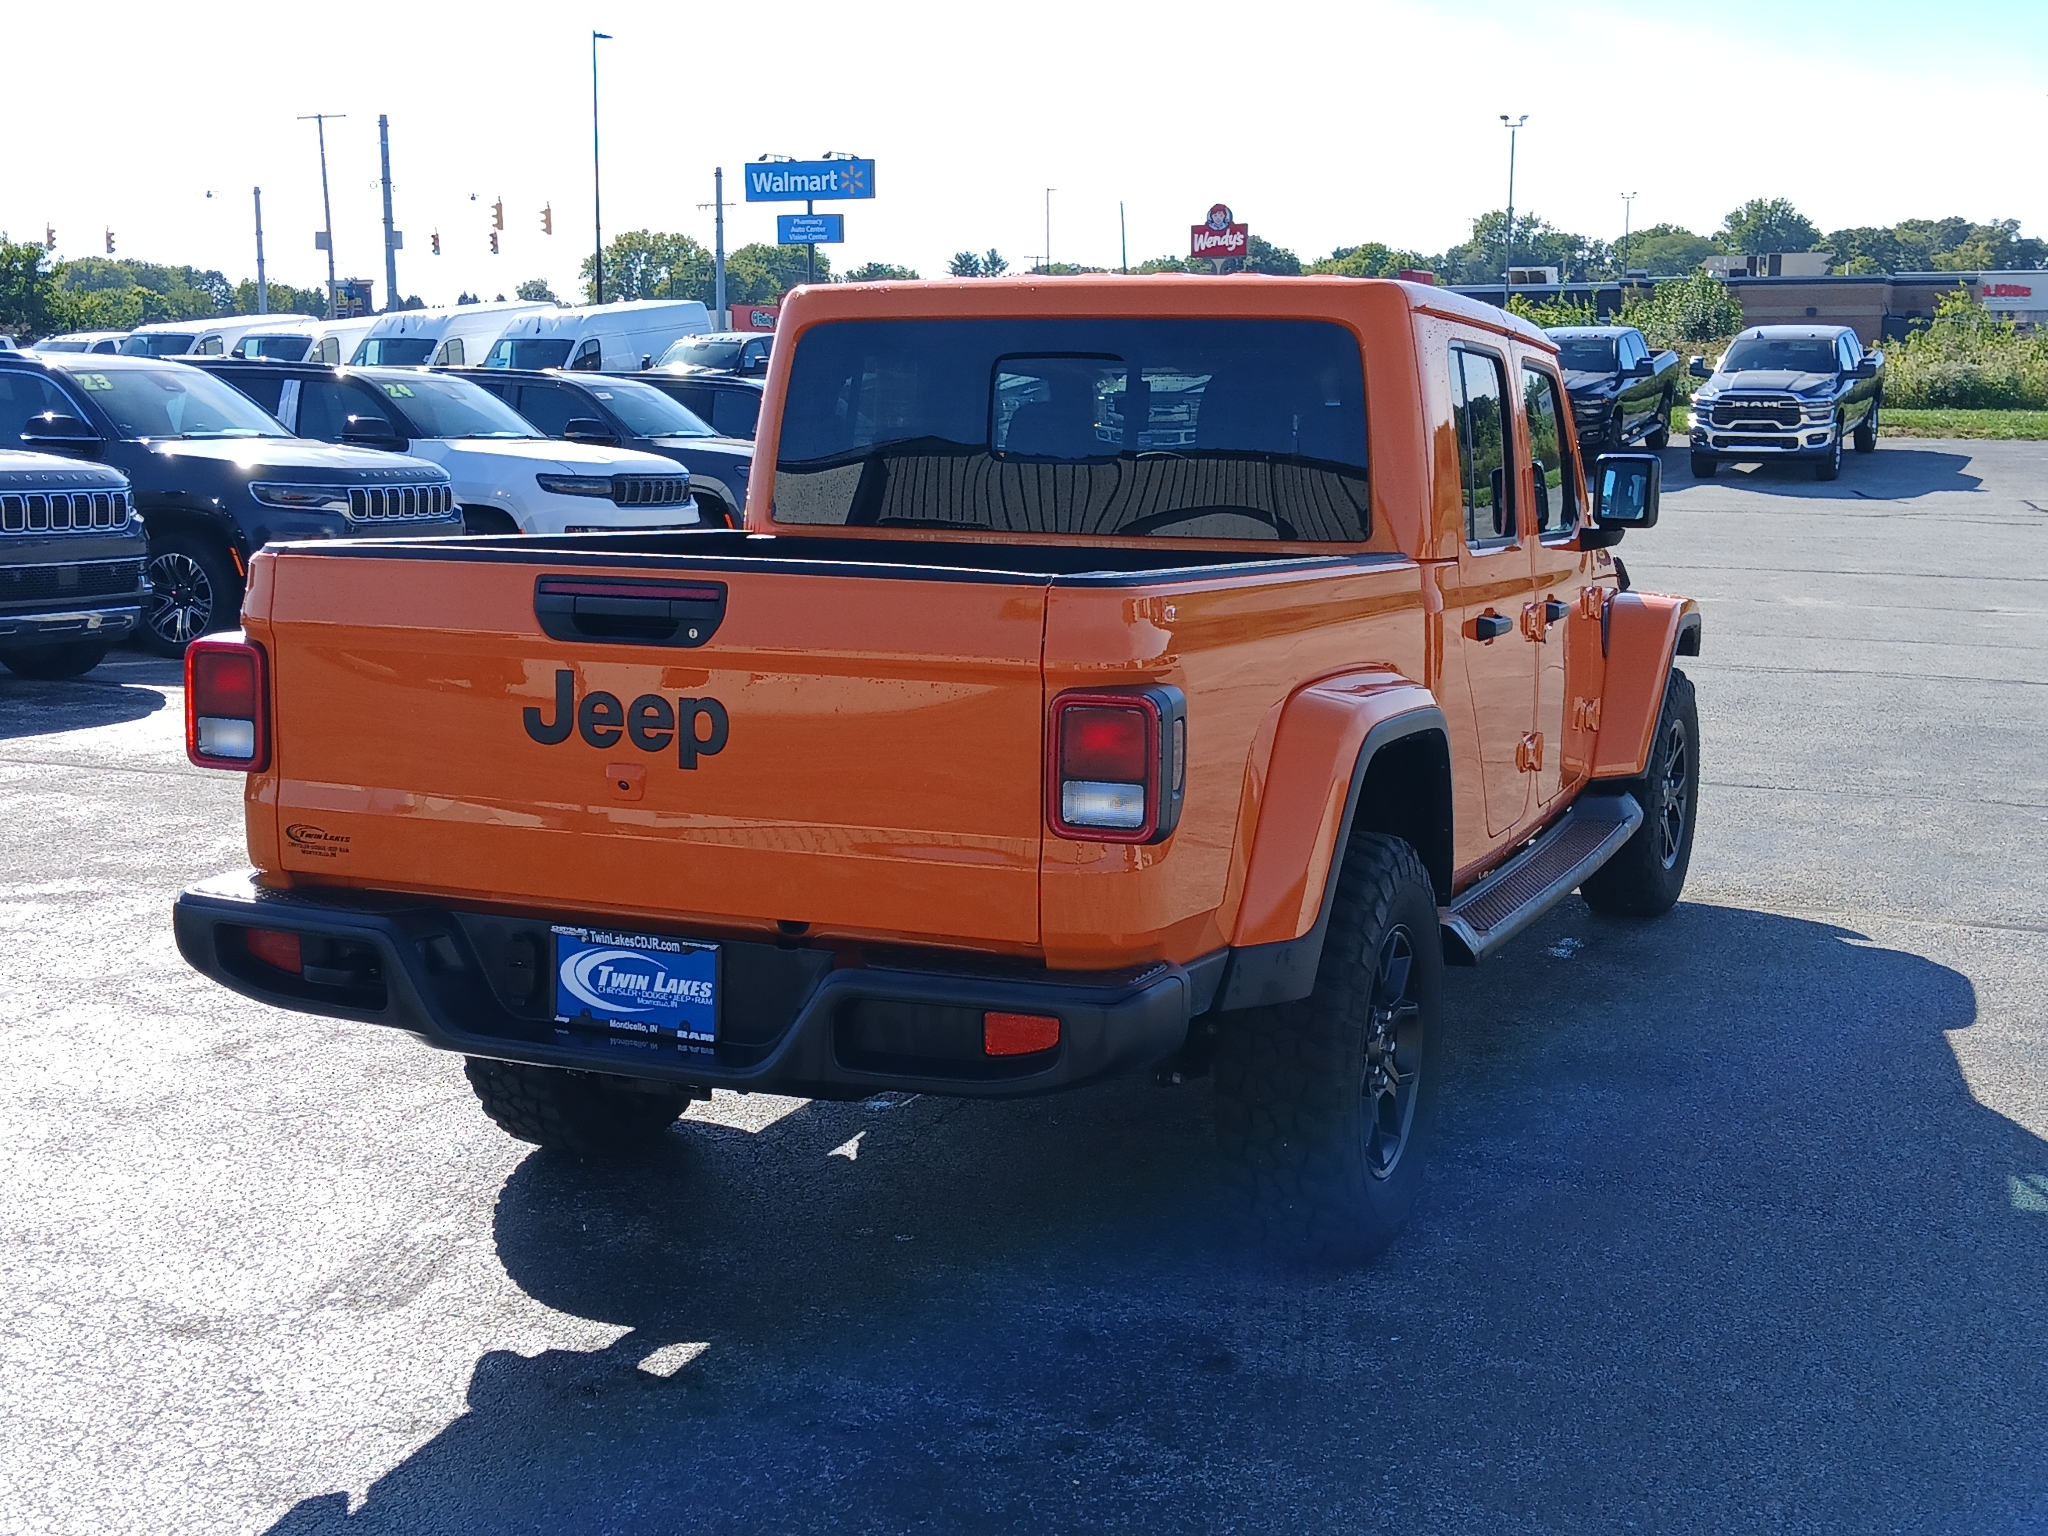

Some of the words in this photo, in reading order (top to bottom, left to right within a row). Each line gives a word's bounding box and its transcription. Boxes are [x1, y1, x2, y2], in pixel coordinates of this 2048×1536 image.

[752, 170, 838, 193] Walmart
[788, 233, 807, 241] Vision
[808, 233, 829, 241] Center
[1194, 228, 1245, 253] Wendy's
[72, 373, 114, 390] 23
[381, 383, 416, 398] 24
[523, 669, 730, 770] Jeep
[589, 930, 680, 952] TwinLakesCDJR.com
[598, 966, 649, 991] TWIN
[654, 971, 713, 998] LAKES
[642, 990, 669, 1000] DODGE
[672, 994, 691, 1003] JEEP
[694, 997, 713, 1006] RAM
[609, 1019, 648, 1034] Monticello,
[649, 1024, 658, 1033] IN
[677, 1030, 715, 1042] RAM
